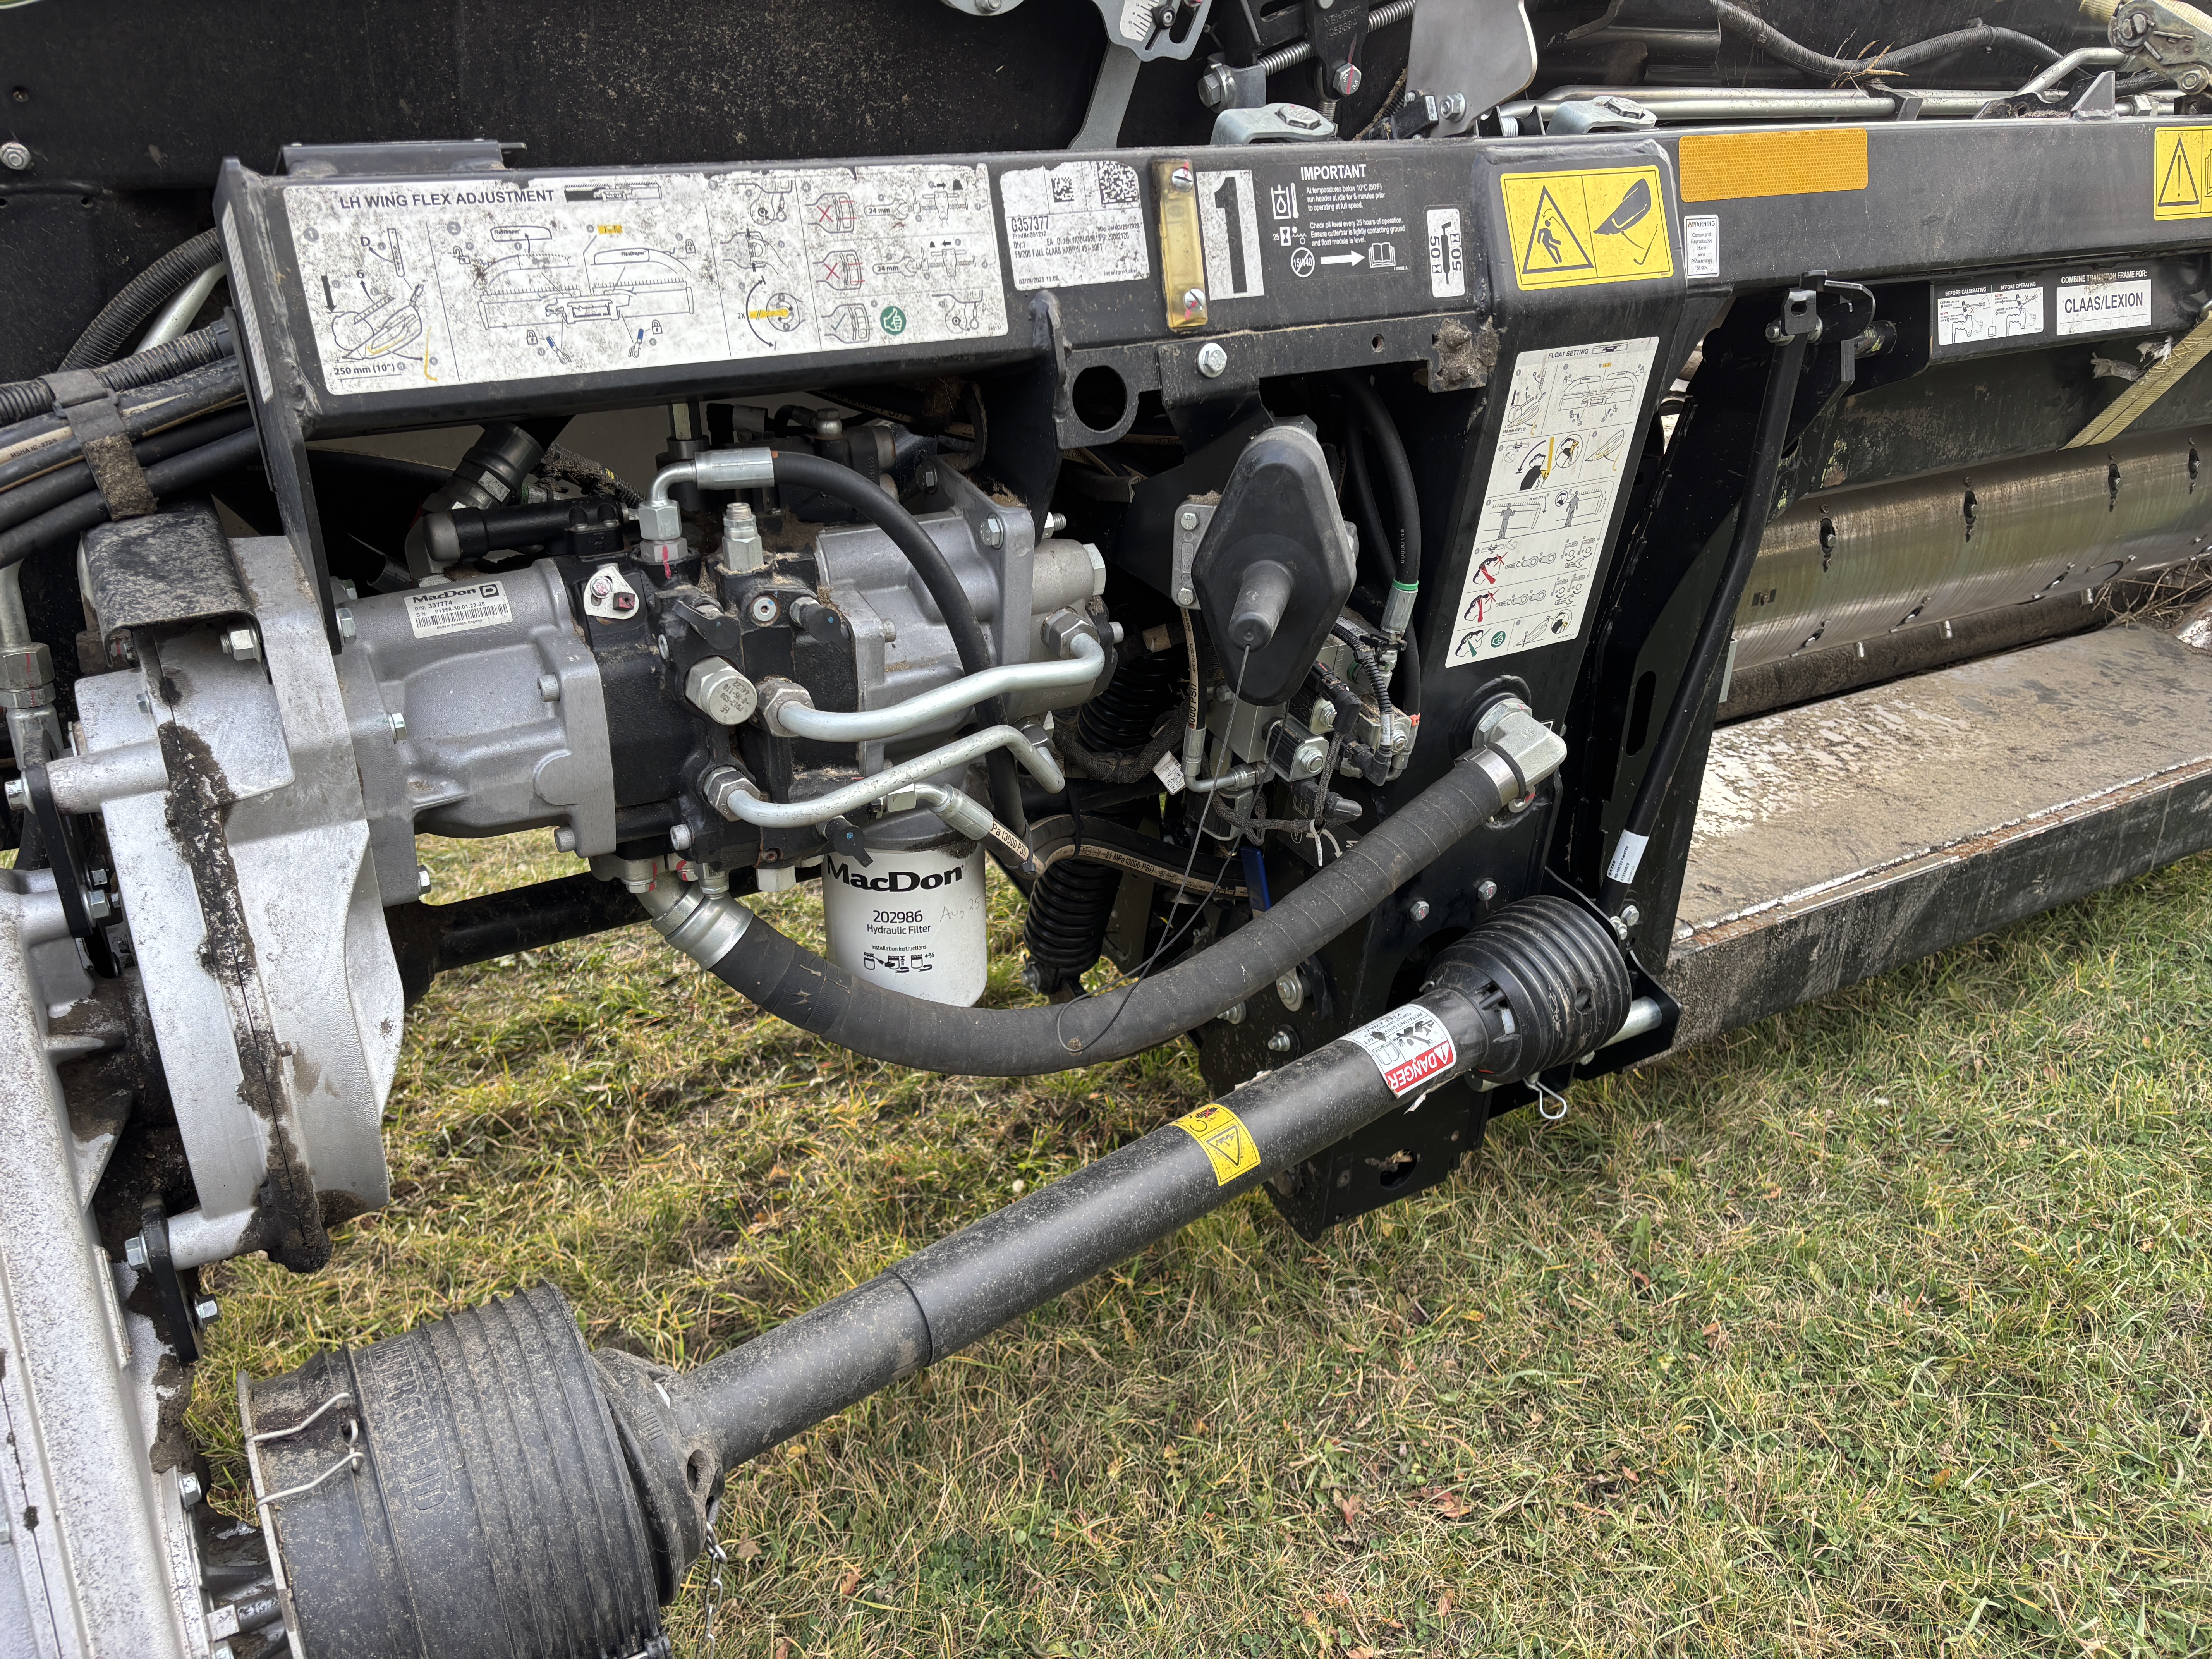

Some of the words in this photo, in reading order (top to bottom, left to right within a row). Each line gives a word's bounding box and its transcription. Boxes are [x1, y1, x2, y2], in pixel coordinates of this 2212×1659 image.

[1300, 163, 1367, 181] IMPORTANT
[1312, 185, 1342, 194] temperatures
[340, 196, 361, 210] LH
[365, 194, 408, 208] WING
[412, 193, 452, 206] FLEX
[456, 189, 555, 205] ADJUSTMENT
[1314, 203, 1335, 212] operating
[1348, 201, 1363, 210] speed.
[1011, 216, 1049, 232] G357377
[1310, 221, 1325, 230] Check
[1343, 220, 1356, 228] every
[1381, 217, 1403, 226] operation.
[1213, 177, 1248, 295] 1
[1310, 230, 1327, 238] Ensure
[1328, 228, 1348, 237] cutterbar
[1353, 228, 1367, 237] lightly
[1367, 226, 1389, 235] contacting
[1390, 225, 1405, 234] ground
[360, 236, 371, 247] D
[1430, 235, 1441, 259] 50
[1032, 249, 1045, 257] FULL
[1046, 247, 1061, 256] CLAAS
[1451, 248, 1462, 271] 50
[356, 269, 365, 278] 6
[2061, 275, 2086, 284] COMBINE
[2117, 270, 2135, 279] FRAME
[1945, 288, 1961, 297] BEFORE
[2064, 292, 2143, 314] CLAAS/LEXION
[1548, 350, 1566, 359] FLOAT
[1566, 349, 1589, 358] SETTING
[333, 367, 352, 376] 250
[354, 366, 371, 374] mm
[413, 588, 476, 603] MacDon
[428, 600, 453, 609] 337774
[991, 823, 1001, 836] Pa
[1113, 853, 1125, 863] MPa
[1125, 857, 1141, 869] (3000
[1142, 863, 1154, 873] PSI)
[827, 854, 964, 892] MacDon
[873, 910, 923, 924] 202986
[867, 924, 907, 935] Hydraulic
[908, 924, 931, 934] Filter
[1398, 1012, 1423, 1028] ROTATING
[1388, 1052, 1437, 1089] DANGER
